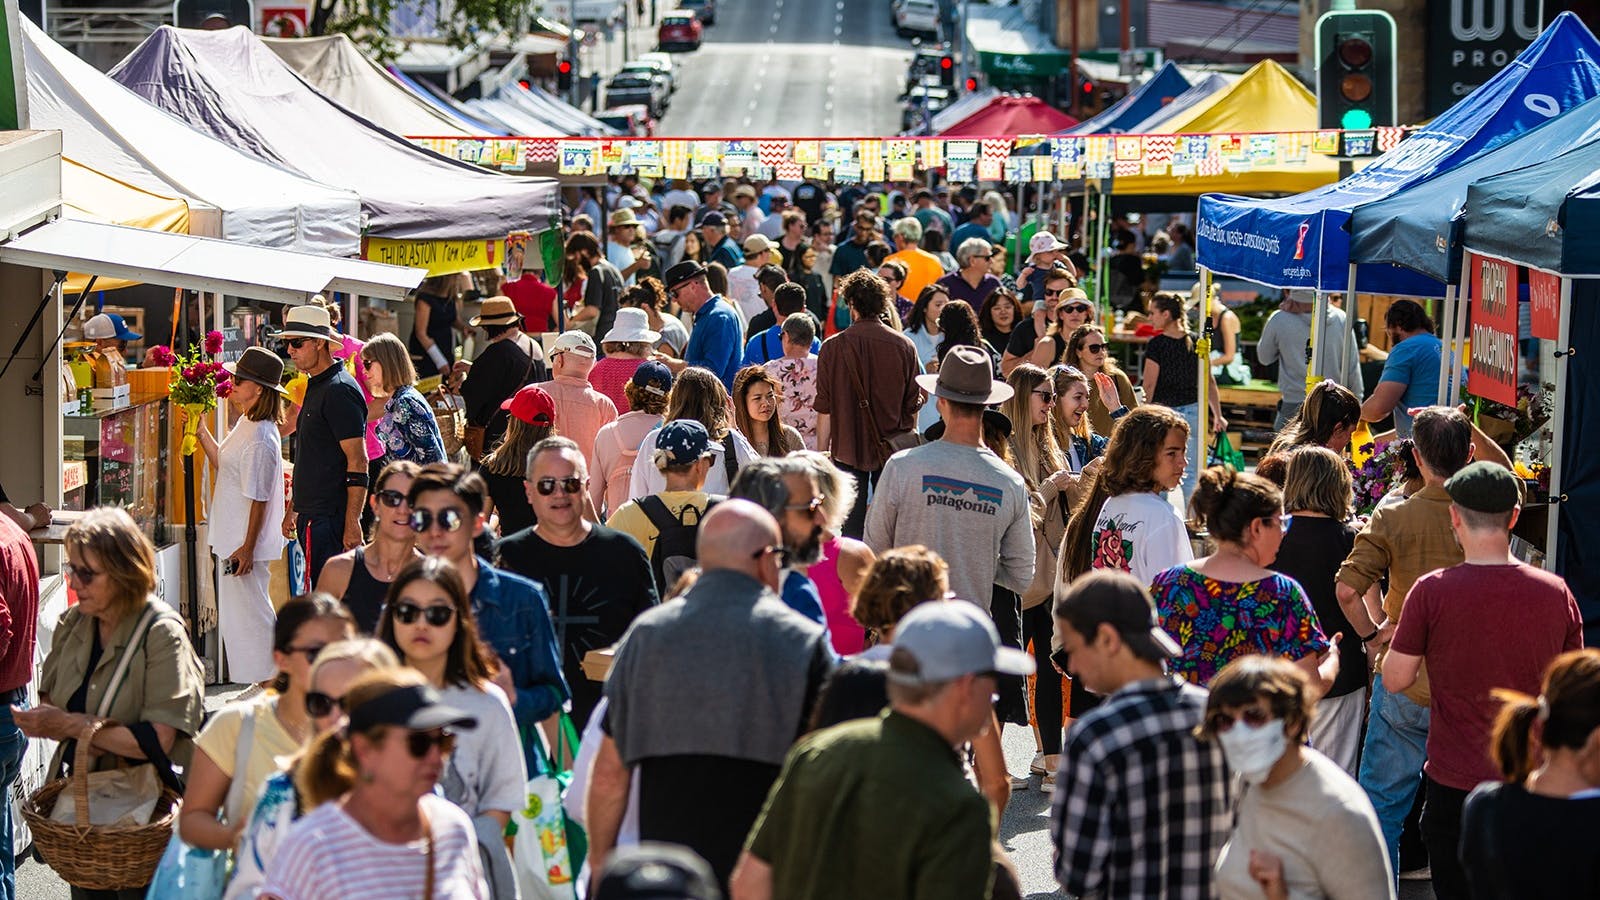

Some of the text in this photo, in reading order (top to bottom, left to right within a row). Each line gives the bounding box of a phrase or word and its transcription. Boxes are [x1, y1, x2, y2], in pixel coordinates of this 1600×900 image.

[1452, 50, 1522, 66] PRO
[380, 240, 437, 266] THURLASTON
[1481, 260, 1508, 309] TROPHY
[1472, 323, 1515, 378] DOUGHNUTS
[926, 494, 997, 516] patagonia
